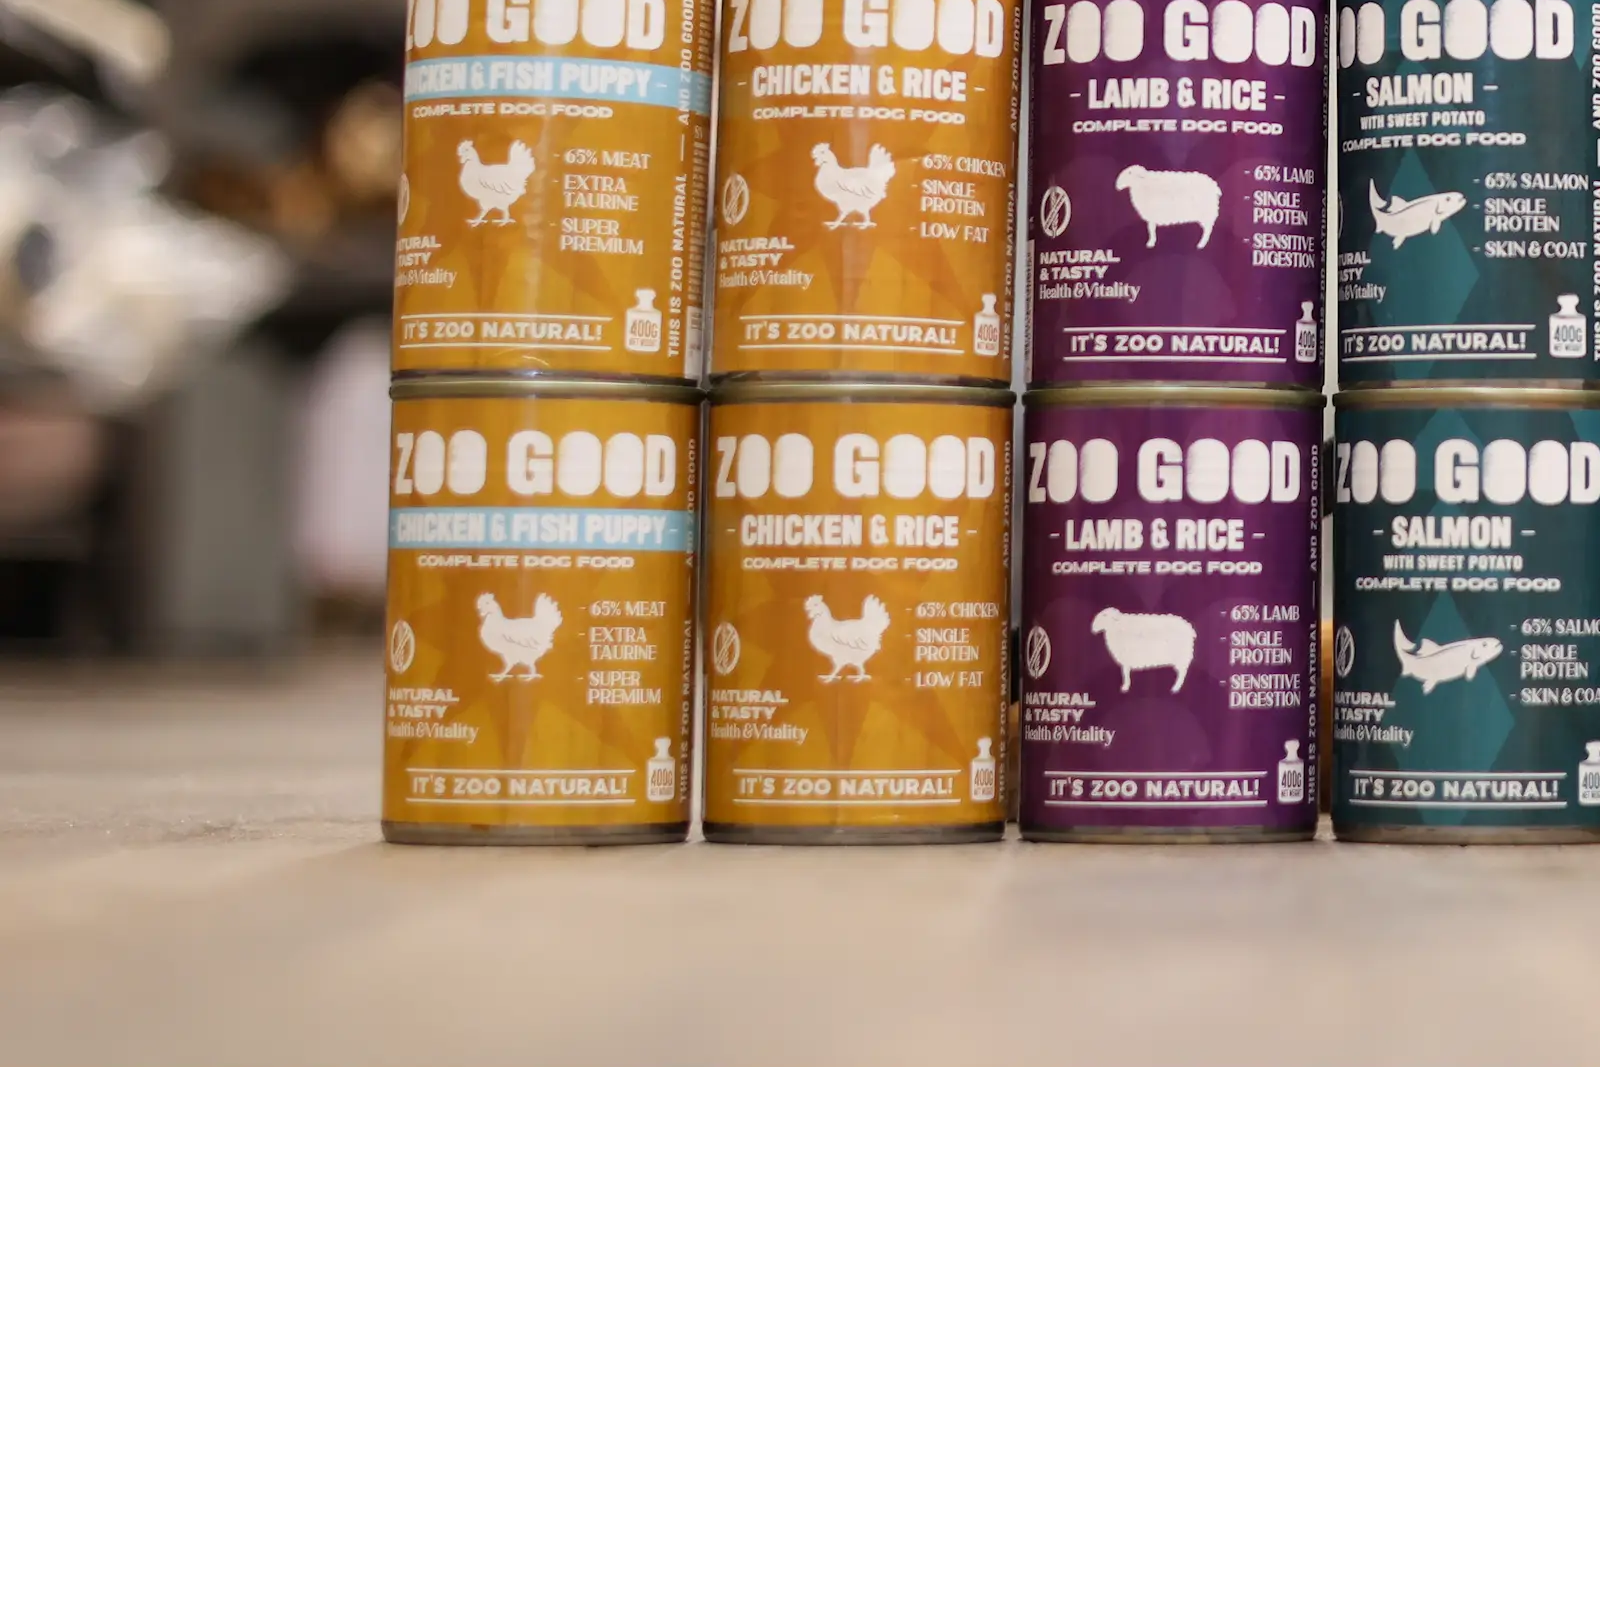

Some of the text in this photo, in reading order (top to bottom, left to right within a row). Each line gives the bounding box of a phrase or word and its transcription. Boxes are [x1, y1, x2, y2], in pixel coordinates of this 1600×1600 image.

[1337, 2, 1385, 69] OO
[752, 65, 967, 101] CHICKEN & RICE
[1366, 72, 1473, 108] SALMON
[1088, 78, 1266, 111] LAMB & RICE
[413, 102, 613, 118] COMPLETE DOG FOOD
[753, 106, 965, 124] COMPLETE DOG FOOD
[1073, 120, 1283, 135] COMPLETE DOG FOOD
[1361, 111, 1486, 129] WITH SWEET POTATO
[1343, 132, 1526, 151] COMPLETE DOG FOOD
[564, 175, 626, 192] EXTRA
[923, 180, 975, 198] SINGLE
[1485, 173, 1588, 190] 65% SALMON
[564, 193, 639, 211] TAURINE
[1254, 191, 1300, 208] SINGLE
[1485, 198, 1546, 215] SINGLE
[562, 218, 619, 236] SUPER
[921, 223, 989, 242] LOW FAT
[561, 235, 644, 254] PREMIUM
[720, 237, 794, 252] NATURAL
[1253, 234, 1314, 252] SENSITIVE
[1040, 250, 1120, 264] NATURAL
[1253, 250, 1315, 268] DIGESTION
[434, 321, 474, 338] ZOO
[482, 322, 603, 341] NATURAL!
[745, 320, 956, 344] IT'S ZOO NATURAL!
[1554, 326, 1582, 343] 400G
[1071, 334, 1107, 352] IT'S
[1115, 335, 1163, 352] ZOO
[1172, 336, 1280, 354] NATURAL!
[1368, 334, 1405, 352] ZOO
[1412, 332, 1526, 351] NATURAL!
[395, 430, 677, 497] ZOO GOOD
[716, 433, 995, 499] ZOO GOOD
[1029, 438, 1301, 503] ZOO GOOD
[1337, 439, 1416, 504] ZOO
[397, 512, 482, 544] CHICKEN
[512, 514, 576, 544] FISH
[585, 515, 666, 546] PUPPY
[742, 515, 959, 547] CHICKEN & RICE
[1066, 518, 1244, 551] LAMB & RICE
[1391, 515, 1511, 548] SALMON
[418, 554, 634, 568] COMPLETE DOG FOOD
[742, 557, 957, 570] COMPLETE DOG FOOD
[1052, 560, 1262, 574] COMPLETE DOG FOOD
[1384, 554, 1523, 572] WITH SWEET POTATO
[1356, 577, 1560, 591] COMPLETE DOG FOOD
[1231, 605, 1300, 621] 65% LAMB
[589, 626, 647, 643] EXTRA
[917, 628, 969, 644] SINGLE
[1522, 619, 1552, 635] 65%
[1231, 631, 1282, 647] SINGLE
[590, 644, 656, 661] TAURINE
[1522, 644, 1577, 661] SINGLE
[589, 671, 640, 687] SUPER
[1231, 674, 1300, 690] SENSITIVE
[588, 688, 661, 704] PREMIUM
[1026, 692, 1096, 706] NATURAL
[1230, 692, 1301, 708] DIGESTION
[452, 778, 500, 795] ZOO
[509, 778, 627, 796] NATURAL!
[740, 777, 775, 795] IT'S
[783, 778, 831, 795] ZOO
[840, 778, 953, 796] NATURAL!
[1051, 777, 1260, 798] IT'S ZOO NATURAL!
[1354, 776, 1558, 799] IT'S ZOO NATURAL!
